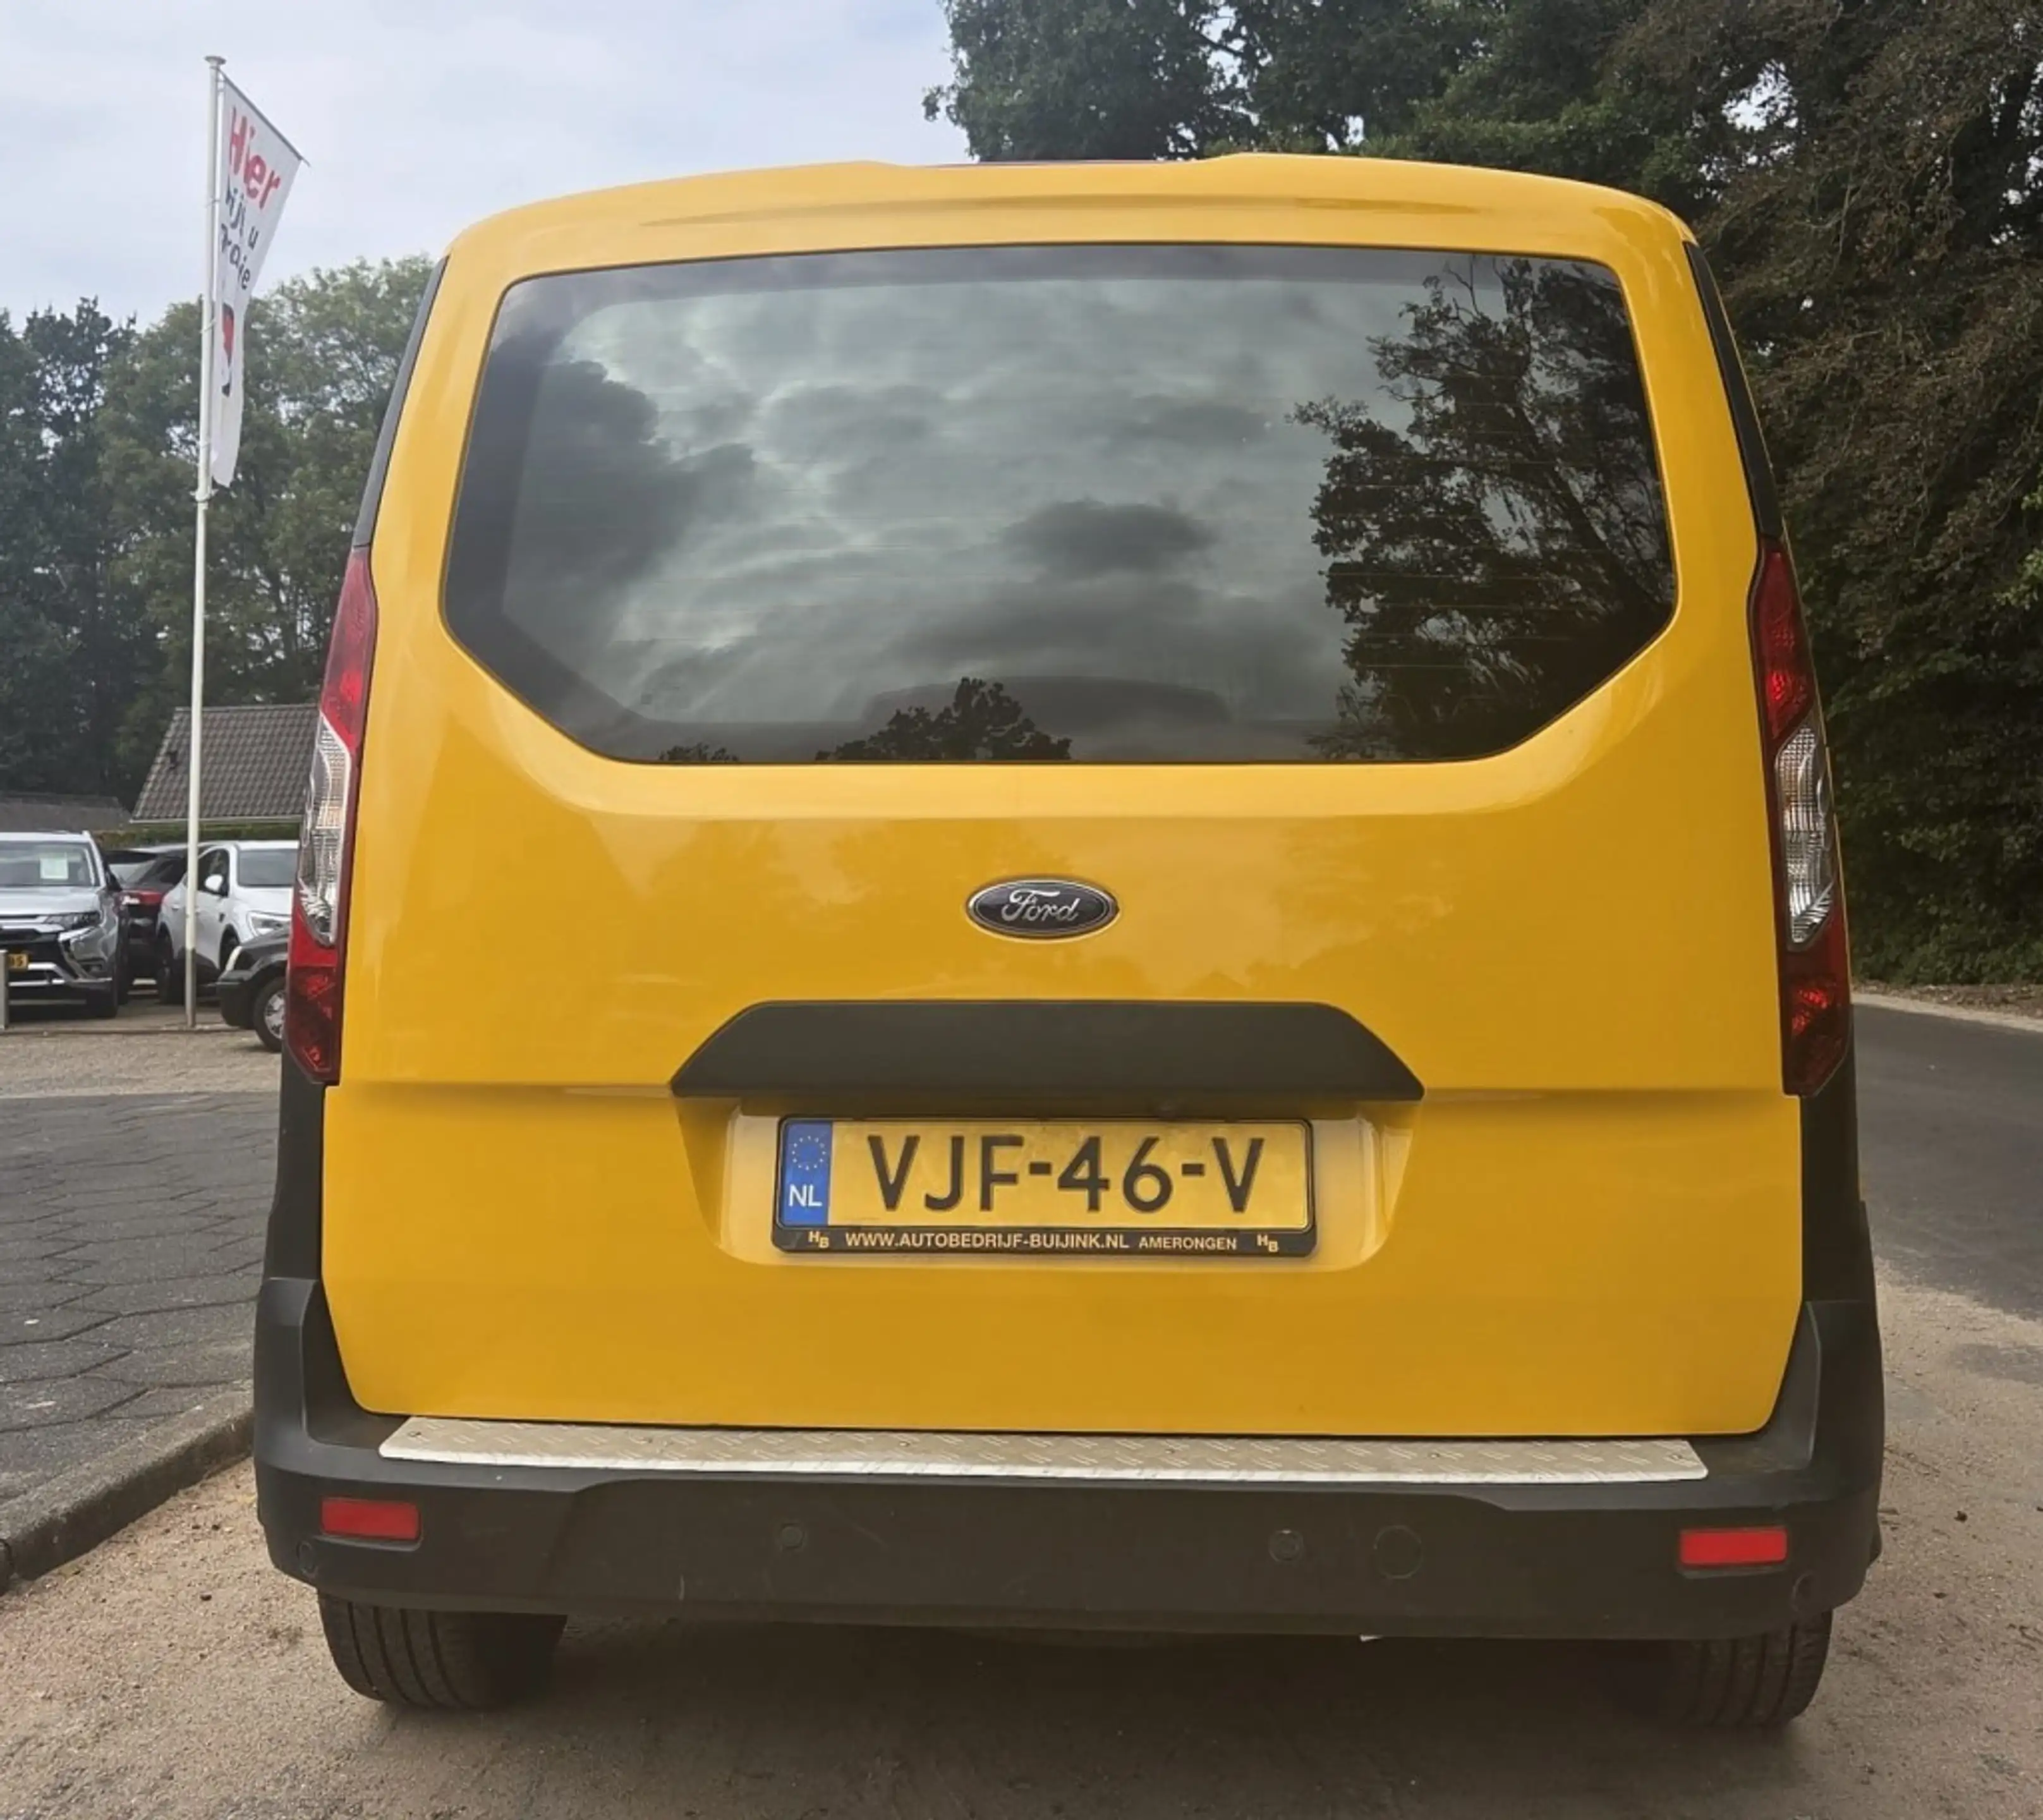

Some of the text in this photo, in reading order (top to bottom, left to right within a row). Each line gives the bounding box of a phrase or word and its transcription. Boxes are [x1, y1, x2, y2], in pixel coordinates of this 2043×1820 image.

[229, 106, 281, 209] Hier
[1001, 888, 1081, 921] Ford
[868, 1134, 1264, 1214] VJF-46-V
[789, 1184, 823, 1208] NL
[845, 1232, 1130, 1250] WWW.AUTOBEDRIJF-BUIJINK.NL
[1139, 1235, 1237, 1251] AMERONGEN
